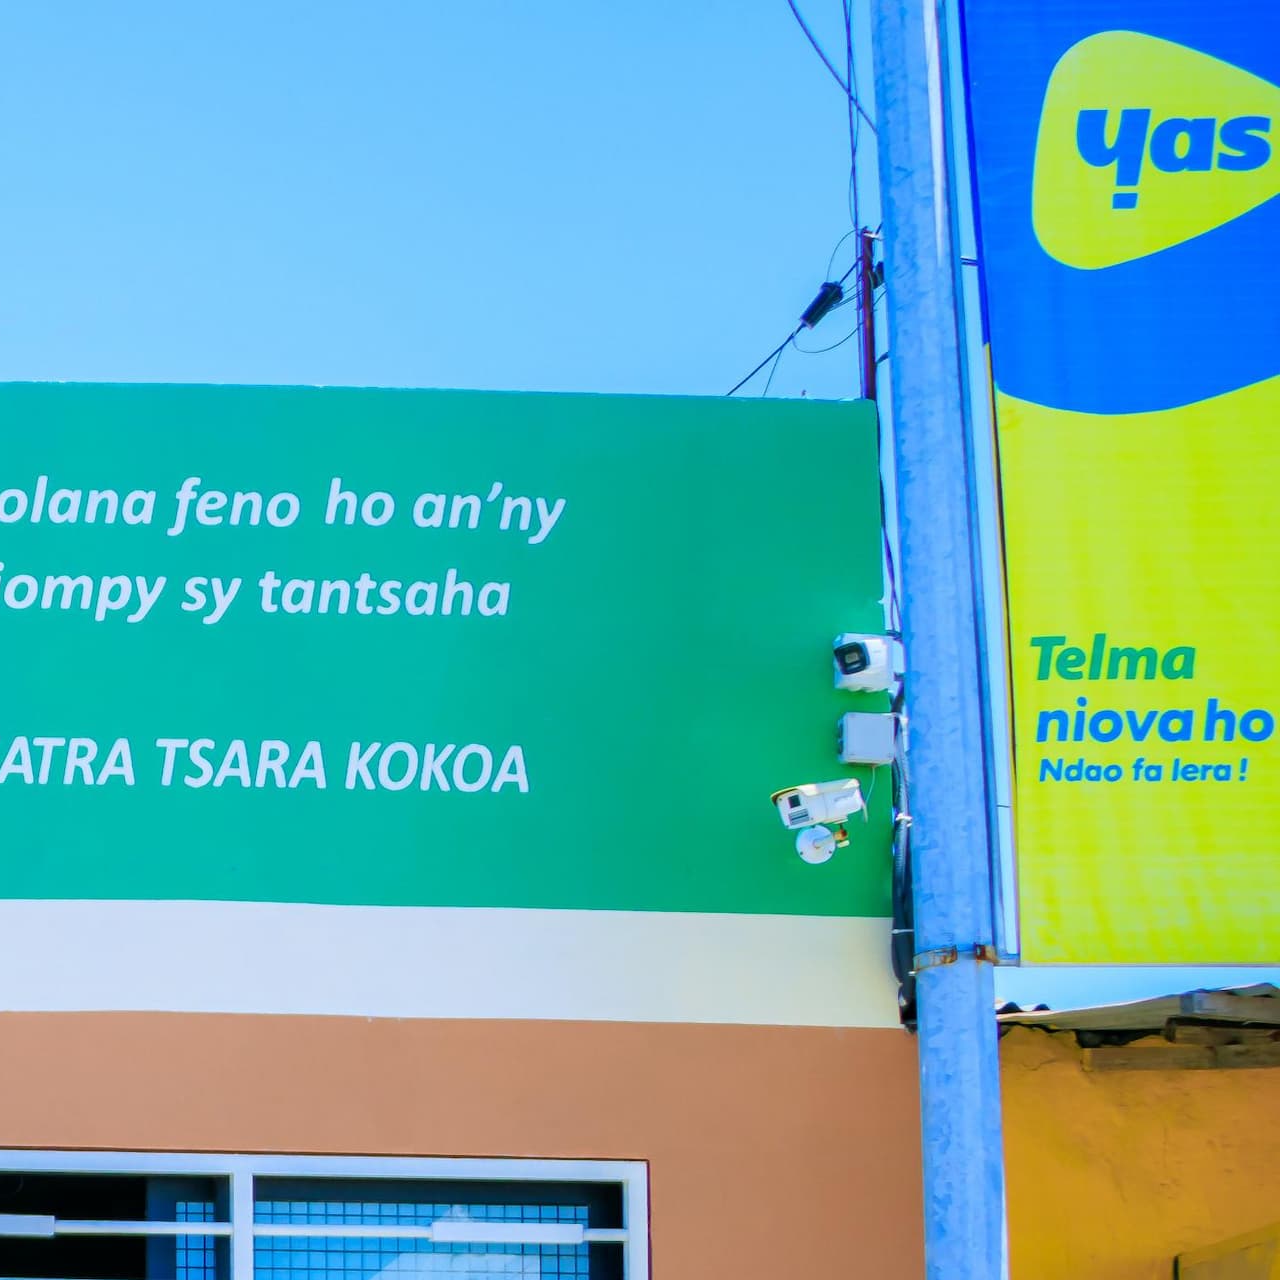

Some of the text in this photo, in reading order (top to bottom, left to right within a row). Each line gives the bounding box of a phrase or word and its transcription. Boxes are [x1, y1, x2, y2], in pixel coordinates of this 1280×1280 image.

[1075, 108, 1272, 209] yas
[167, 476, 301, 537] feno
[324, 477, 395, 527] ho
[180, 574, 241, 625] sy
[258, 568, 512, 617] tantsaha
[1029, 632, 1196, 681] Telma
[156, 738, 327, 790] TSARA
[345, 742, 530, 793] KOKOA
[1039, 757, 1124, 782] Ndao
[1132, 757, 1163, 782] fa
[1171, 757, 1232, 782] lera
